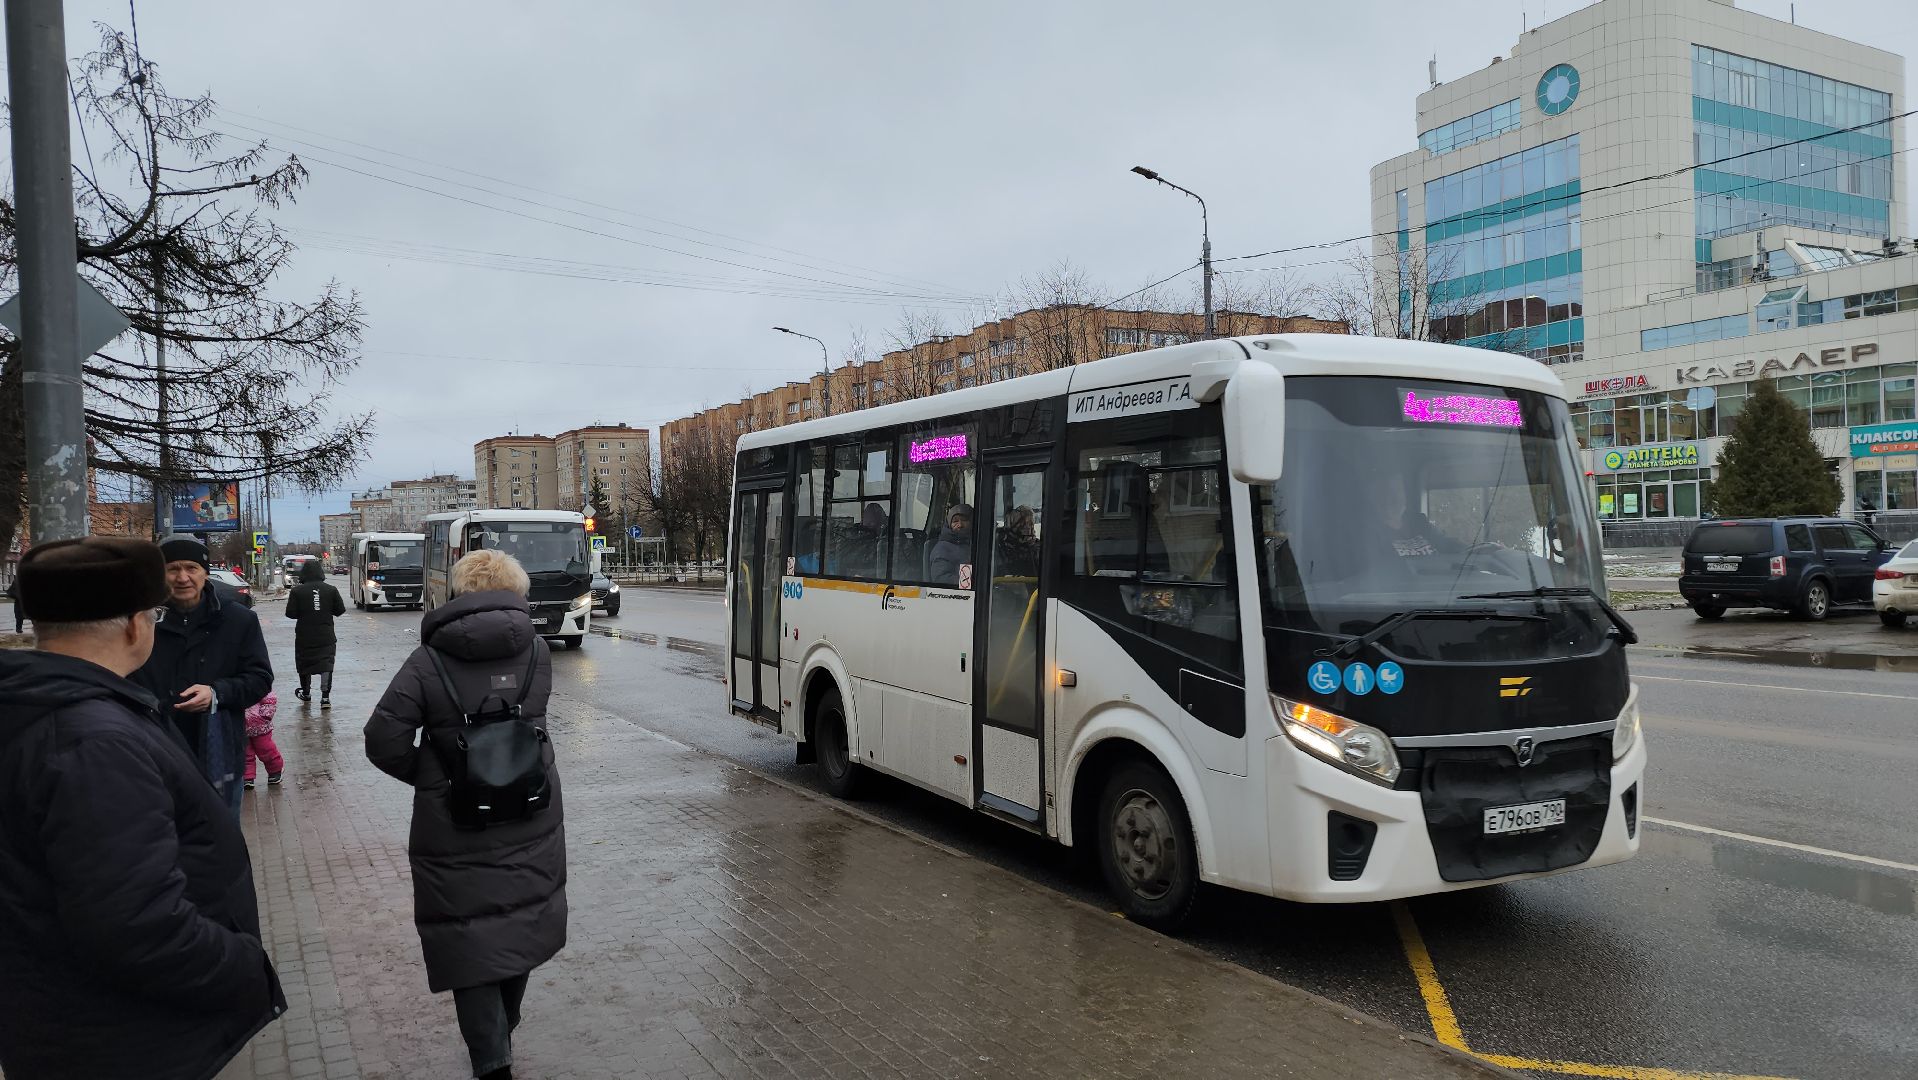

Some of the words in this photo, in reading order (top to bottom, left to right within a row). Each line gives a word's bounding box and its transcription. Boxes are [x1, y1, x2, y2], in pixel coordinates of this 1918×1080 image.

[1585, 374, 1648, 393] ШКОЛА
[1075, 396, 1094, 414] ИП
[1097, 390, 1162, 412] Андреева
[1627, 444, 1698, 462] АПТЕКА
[1873, 443, 1918, 452] АВТО
[1627, 460, 1659, 469] ПЛАНЕТА
[1661, 458, 1697, 467] ЗДОРОВЬЯ
